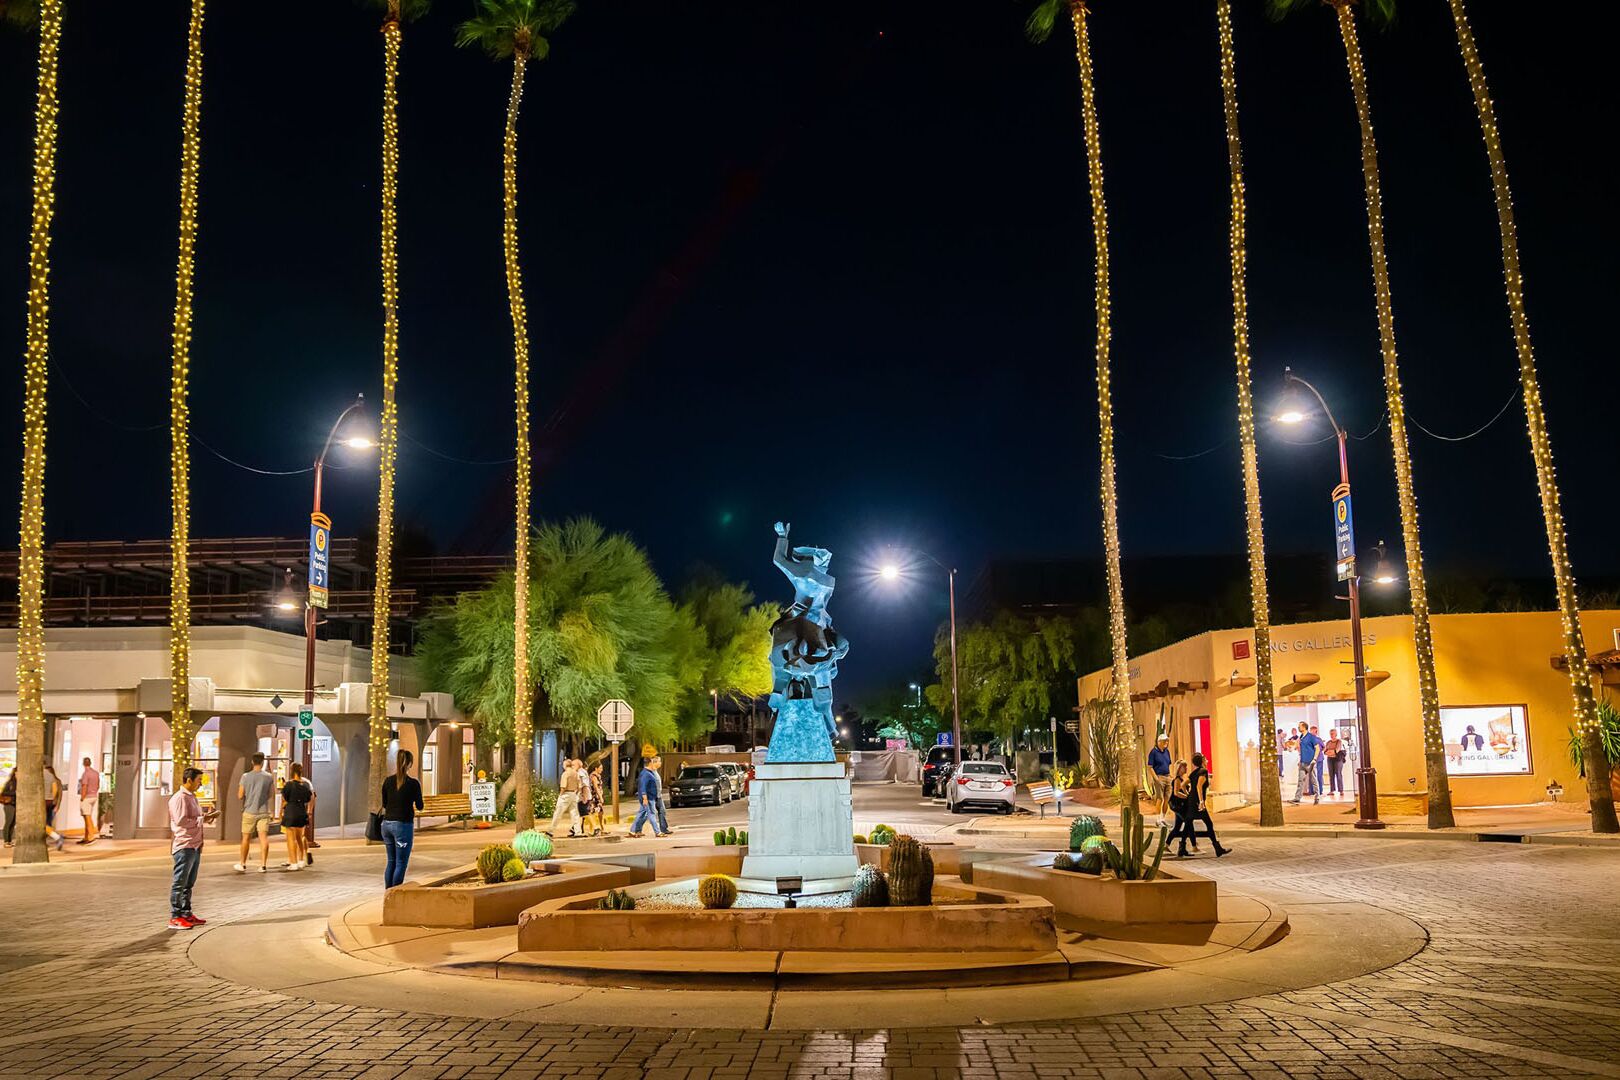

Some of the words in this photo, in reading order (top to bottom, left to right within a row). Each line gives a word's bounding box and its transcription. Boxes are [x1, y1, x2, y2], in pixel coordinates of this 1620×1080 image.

[1339, 523, 1349, 533] Public
[1338, 533, 1351, 543] Parking
[314, 551, 326, 562] Public
[312, 560, 327, 573] Parking
[1293, 634, 1377, 652] GALLERES
